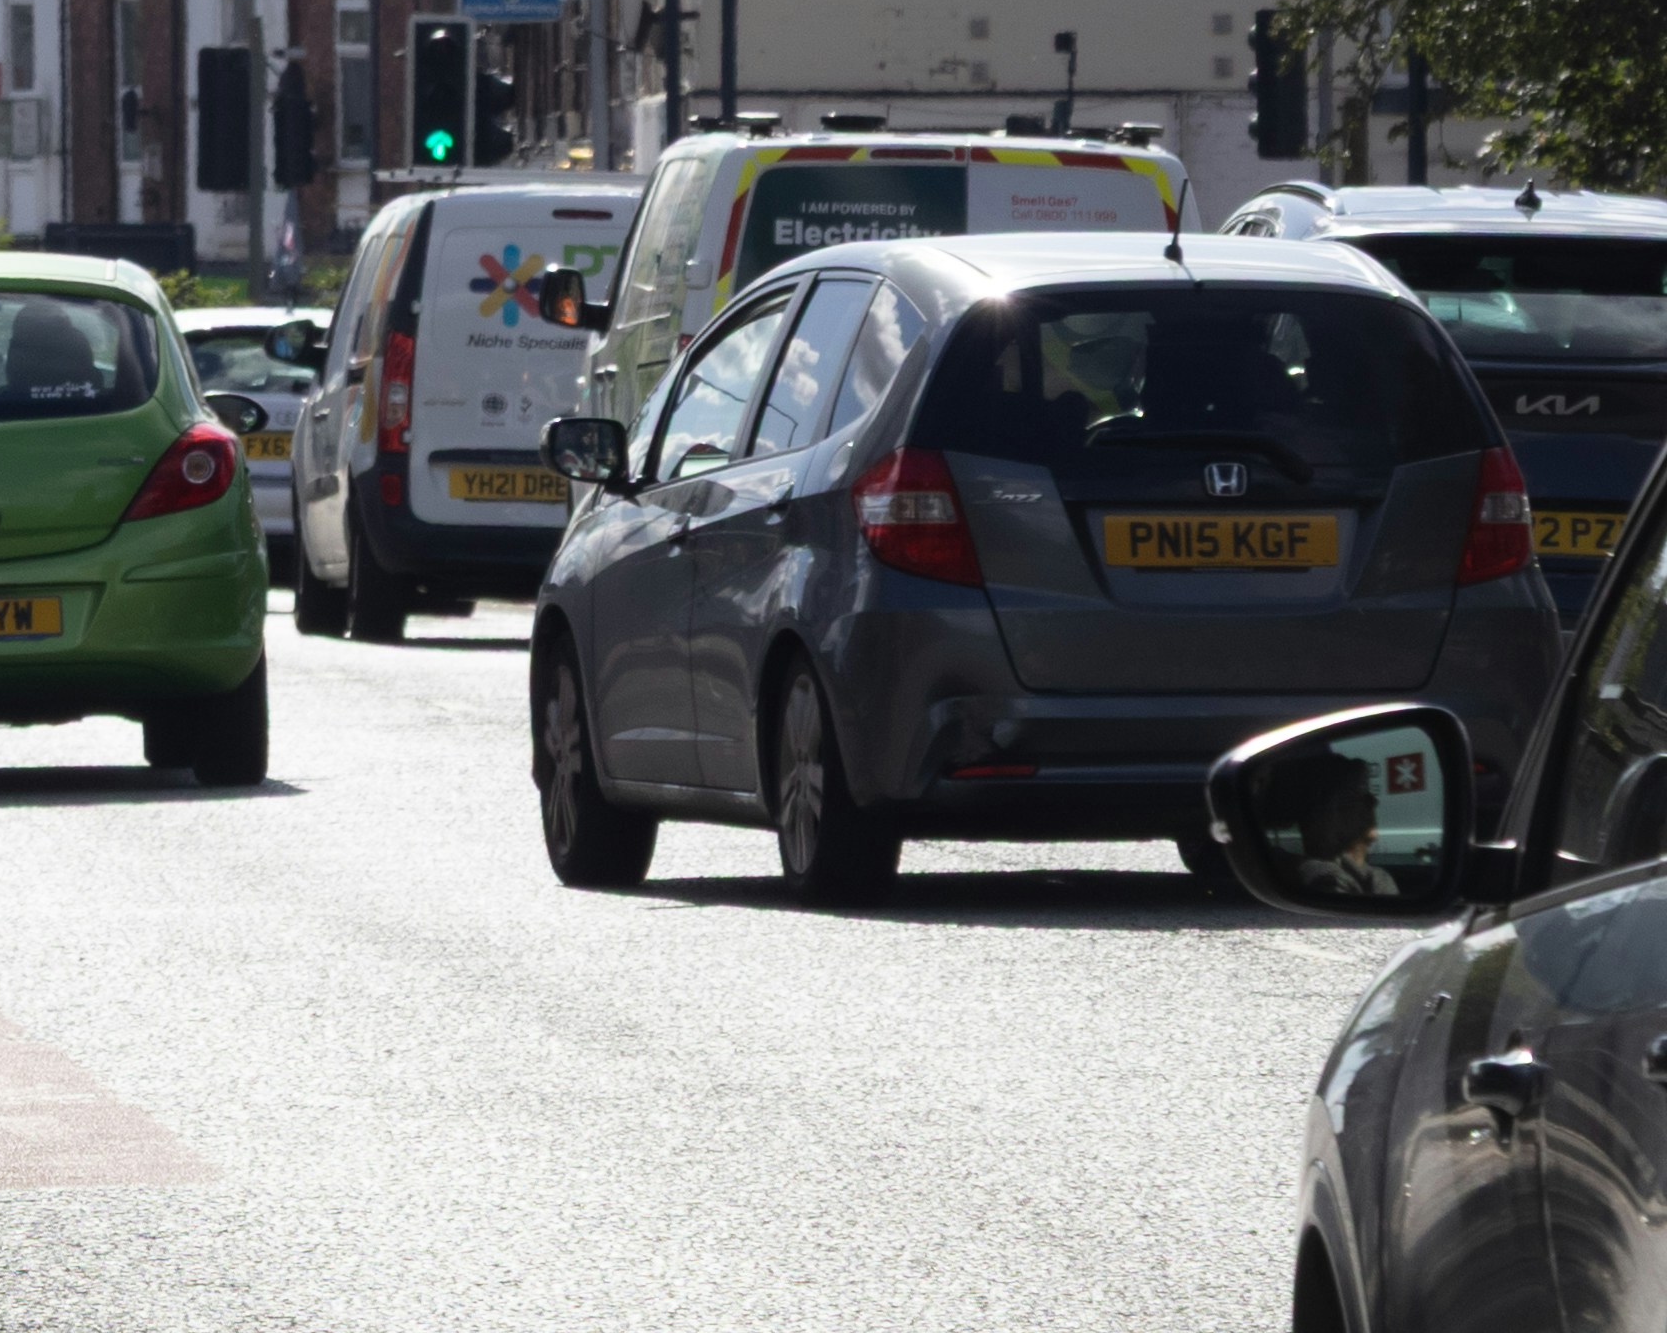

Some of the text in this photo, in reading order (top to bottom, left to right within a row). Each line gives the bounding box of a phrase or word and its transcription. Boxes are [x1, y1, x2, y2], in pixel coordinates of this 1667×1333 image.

[808, 201, 829, 214] AM
[832, 202, 897, 215] POWERED
[900, 204, 917, 216] BY
[1011, 194, 1045, 207] Smell
[774, 218, 943, 246] Electricit
[467, 333, 513, 349] Niche
[463, 472, 517, 495] YH21
[1129, 521, 1311, 558] PN15 KGF
